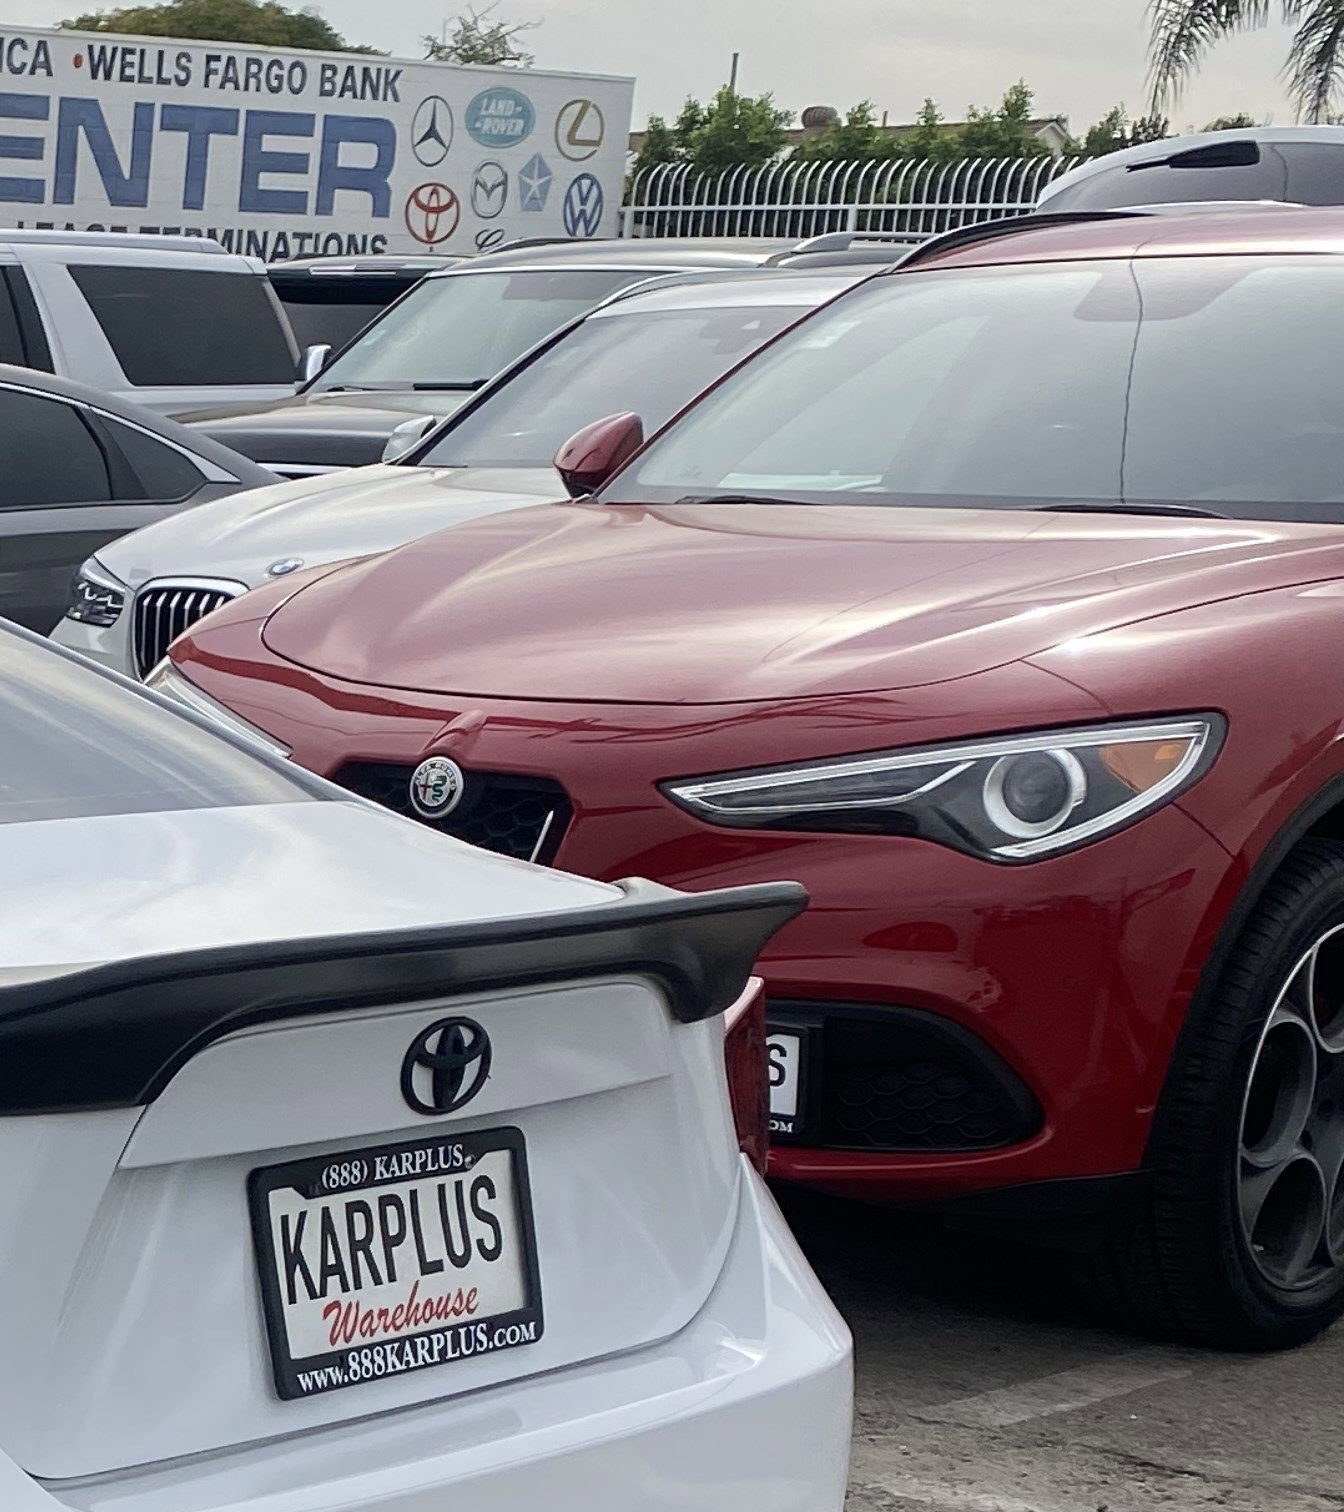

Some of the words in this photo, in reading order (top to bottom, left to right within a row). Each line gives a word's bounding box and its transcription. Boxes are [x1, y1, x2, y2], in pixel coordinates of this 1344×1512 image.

[87, 44, 192, 87] WELLS
[203, 54, 307, 96] FARGO
[318, 64, 403, 102] BANK
[321, 1159, 368, 1190] (888)
[374, 1143, 463, 1181] KARPLUS
[280, 1174, 503, 1306] KARPLUS
[322, 1279, 479, 1347] Warehouse
